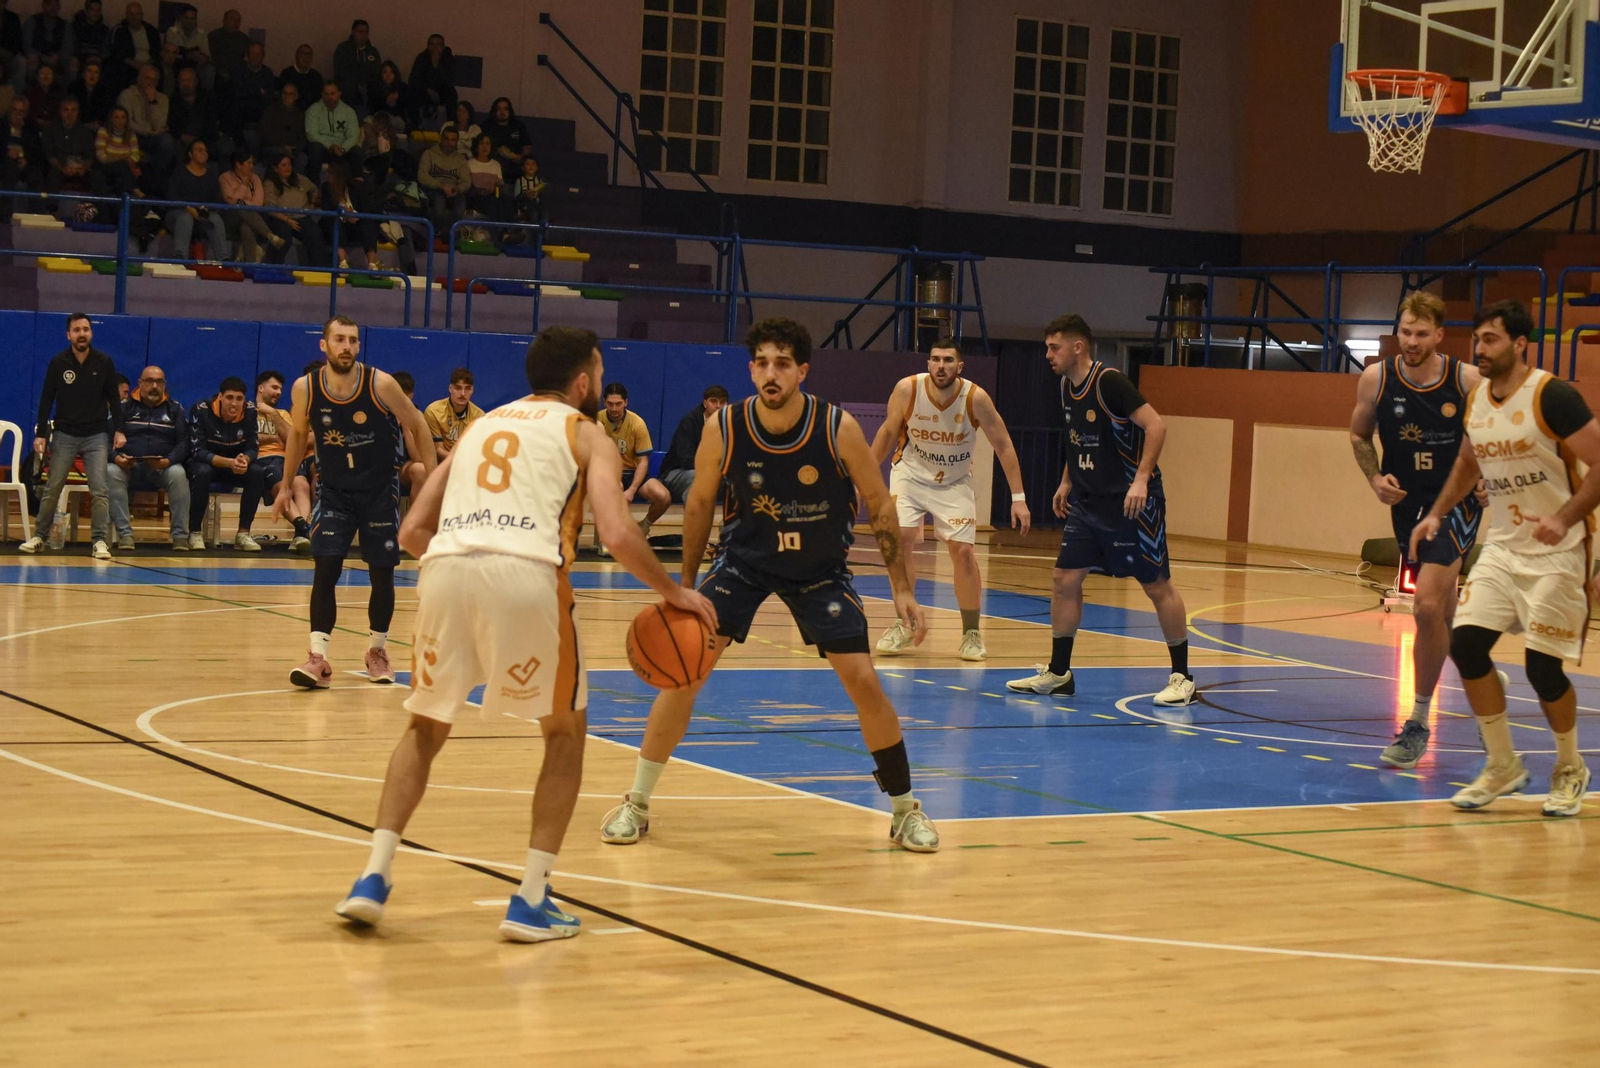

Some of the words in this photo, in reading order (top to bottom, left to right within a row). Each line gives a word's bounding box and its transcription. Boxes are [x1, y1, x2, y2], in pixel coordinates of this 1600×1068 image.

[910, 428, 954, 443] CBCM
[346, 452, 355, 469] 1
[476, 430, 519, 493] 8
[746, 461, 764, 469] vive
[948, 451, 971, 463] OLEA
[1078, 453, 1095, 470] 44
[1413, 452, 1434, 471] 15
[934, 471, 945, 484] 4
[1514, 471, 1549, 488] OLEA
[1508, 504, 1523, 526] 3
[777, 531, 802, 552] 10
[714, 585, 732, 595] vive
